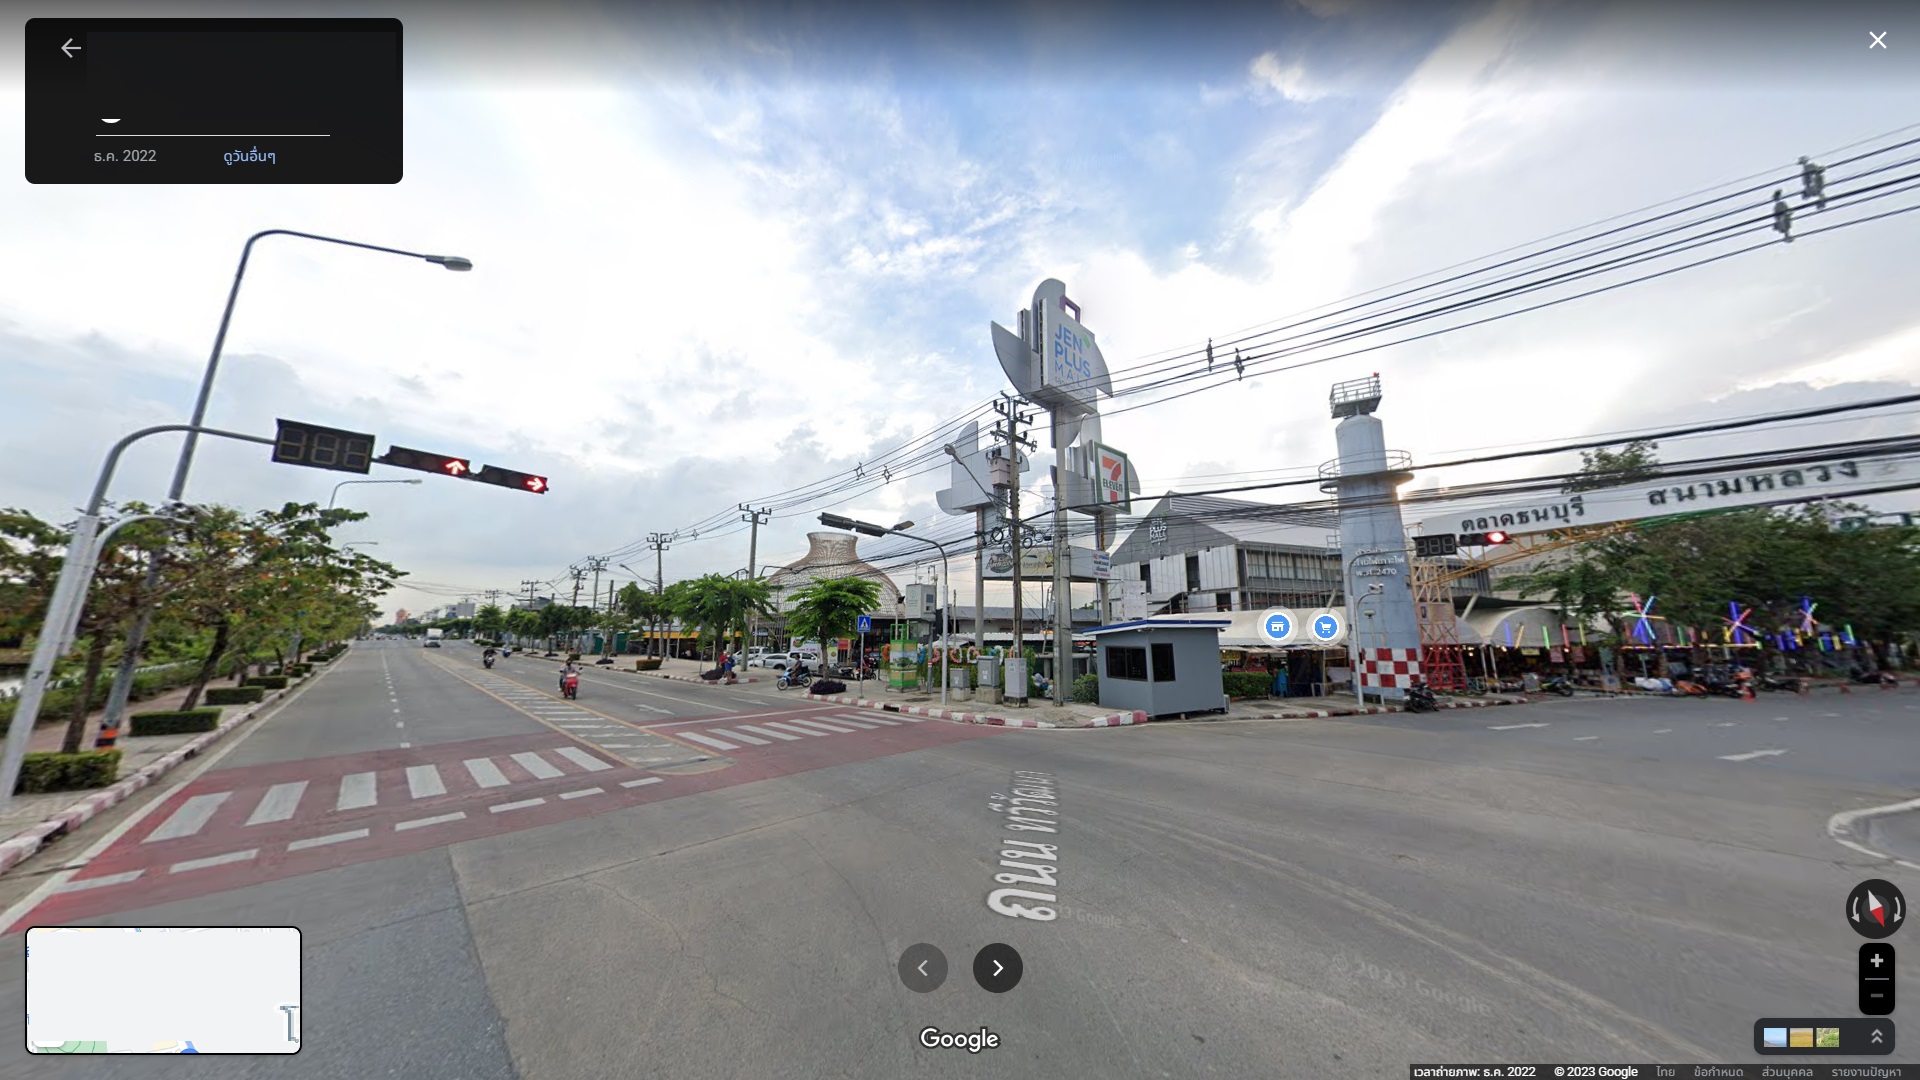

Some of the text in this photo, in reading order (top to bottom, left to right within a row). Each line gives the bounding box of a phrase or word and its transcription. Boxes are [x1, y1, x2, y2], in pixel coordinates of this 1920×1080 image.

[1055, 323, 1083, 355] JEN
[1055, 340, 1091, 378] PLUS
[1055, 360, 1091, 394] MALL
[1102, 455, 1122, 507] 7
[1461, 461, 1860, 532] ตลาดธนบุรี สนามหลวง
